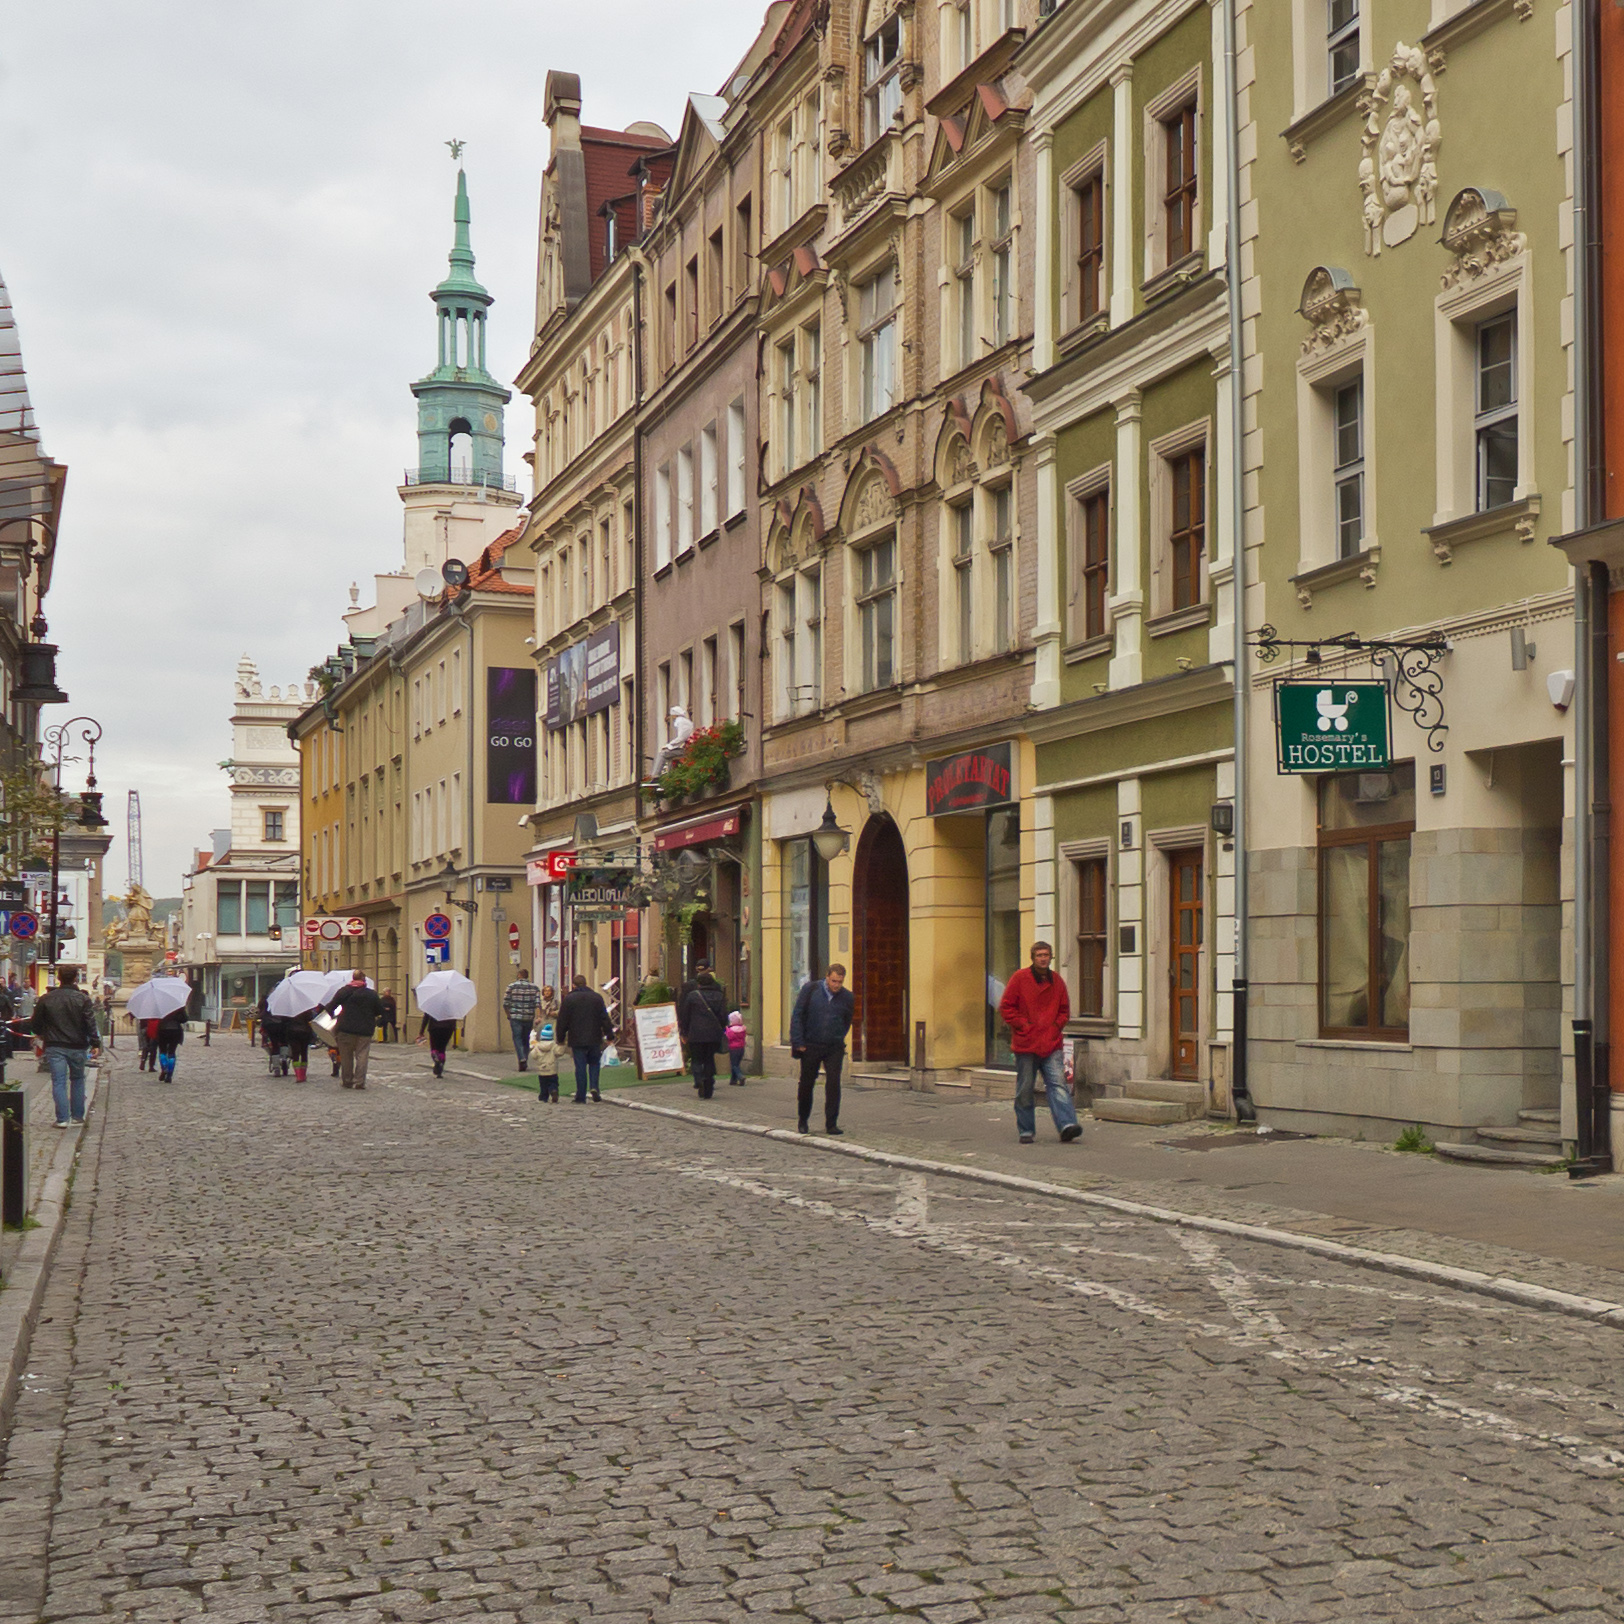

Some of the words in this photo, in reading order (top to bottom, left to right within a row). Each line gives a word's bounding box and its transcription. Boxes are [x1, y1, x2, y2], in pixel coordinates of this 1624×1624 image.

[490, 736, 509, 747] GO
[513, 737, 532, 748] GO
[1301, 732, 1368, 744] Rosemary's
[1288, 744, 1383, 764] HOSTEL
[927, 754, 1011, 813] PROLETARIAT
